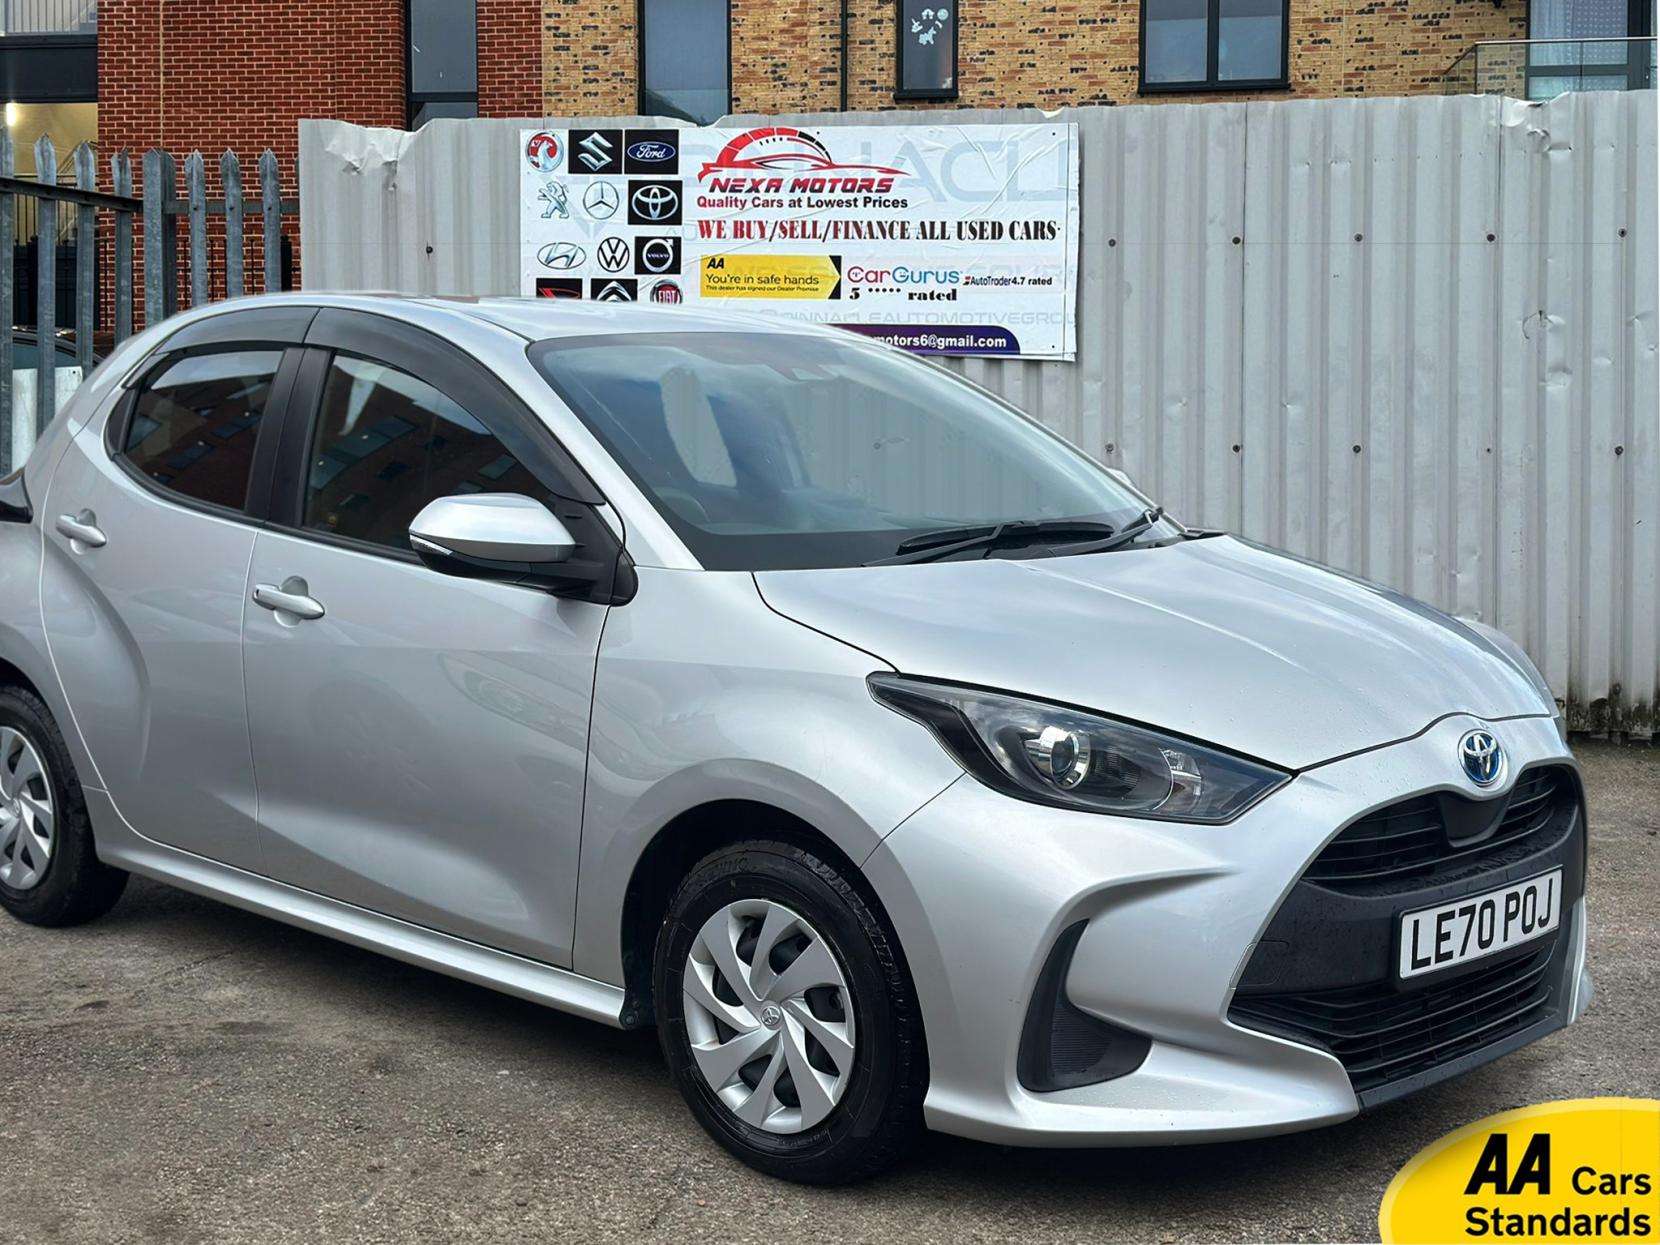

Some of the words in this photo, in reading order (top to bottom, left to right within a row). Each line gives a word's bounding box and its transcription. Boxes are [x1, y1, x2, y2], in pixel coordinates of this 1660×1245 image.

[636, 143, 666, 159] Ford
[709, 177, 784, 194] NEXA
[789, 177, 894, 194] MOTORS
[697, 195, 747, 211] Quality
[751, 196, 784, 209] Cars
[788, 197, 802, 209] at
[807, 196, 859, 209] Lowest
[863, 196, 908, 209] Prices
[697, 219, 727, 240] WE
[733, 219, 911, 243] BUY/SELL/FINANCE
[916, 220, 951, 241] ALL
[957, 220, 1004, 241] USED
[1009, 220, 1057, 241] CARS
[706, 257, 725, 270] AA
[706, 273, 741, 285] You're
[743, 274, 755, 285] in
[757, 274, 781, 285] safe
[784, 274, 820, 286] hands
[847, 266, 960, 284] CarGurus
[1027, 276, 1053, 286] rated
[658, 290, 677, 304] FIAT
[849, 287, 861, 300] 5
[908, 288, 957, 301] rated
[1410, 898, 1496, 971] LE70
[1503, 877, 1553, 943] POJ
